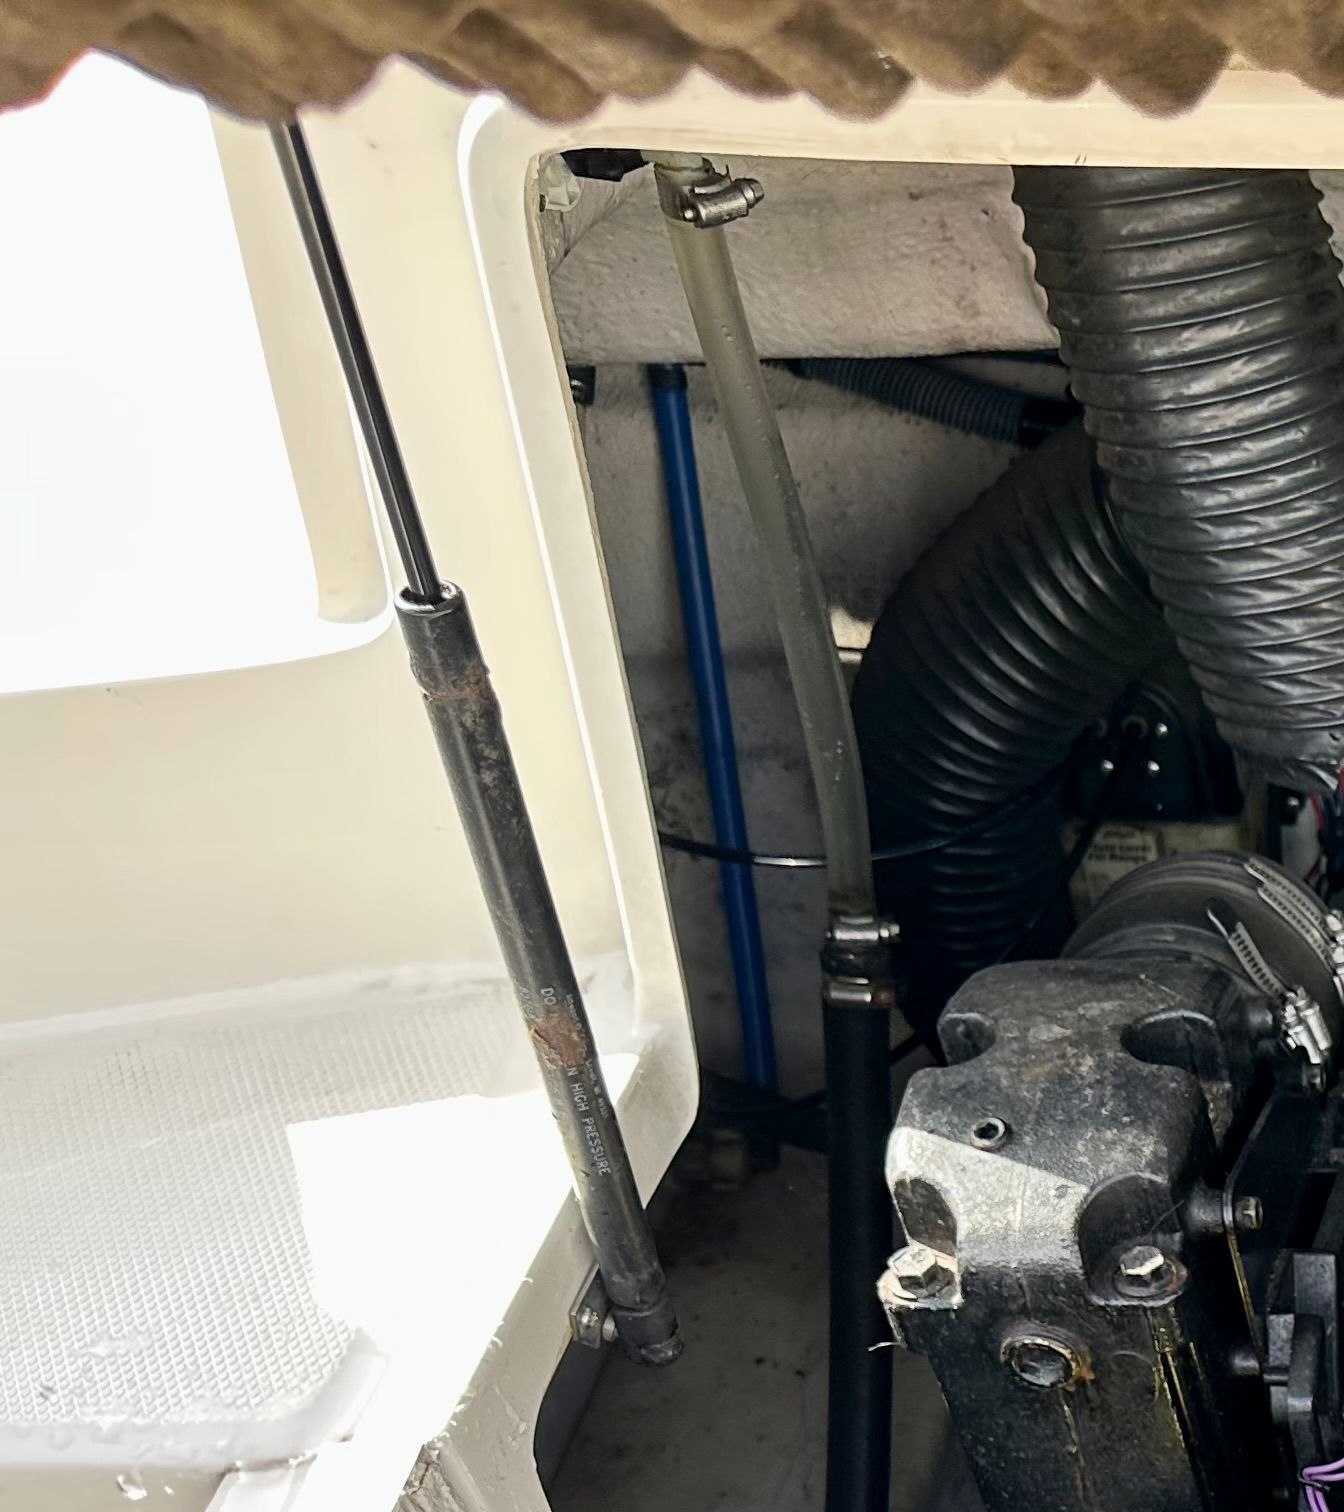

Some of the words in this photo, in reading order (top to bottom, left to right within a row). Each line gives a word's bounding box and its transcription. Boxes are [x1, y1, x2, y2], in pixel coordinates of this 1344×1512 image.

[540, 987, 557, 1006] DO
[570, 1082, 590, 1112] HIGH
[581, 1117, 612, 1176] PRESSURE
